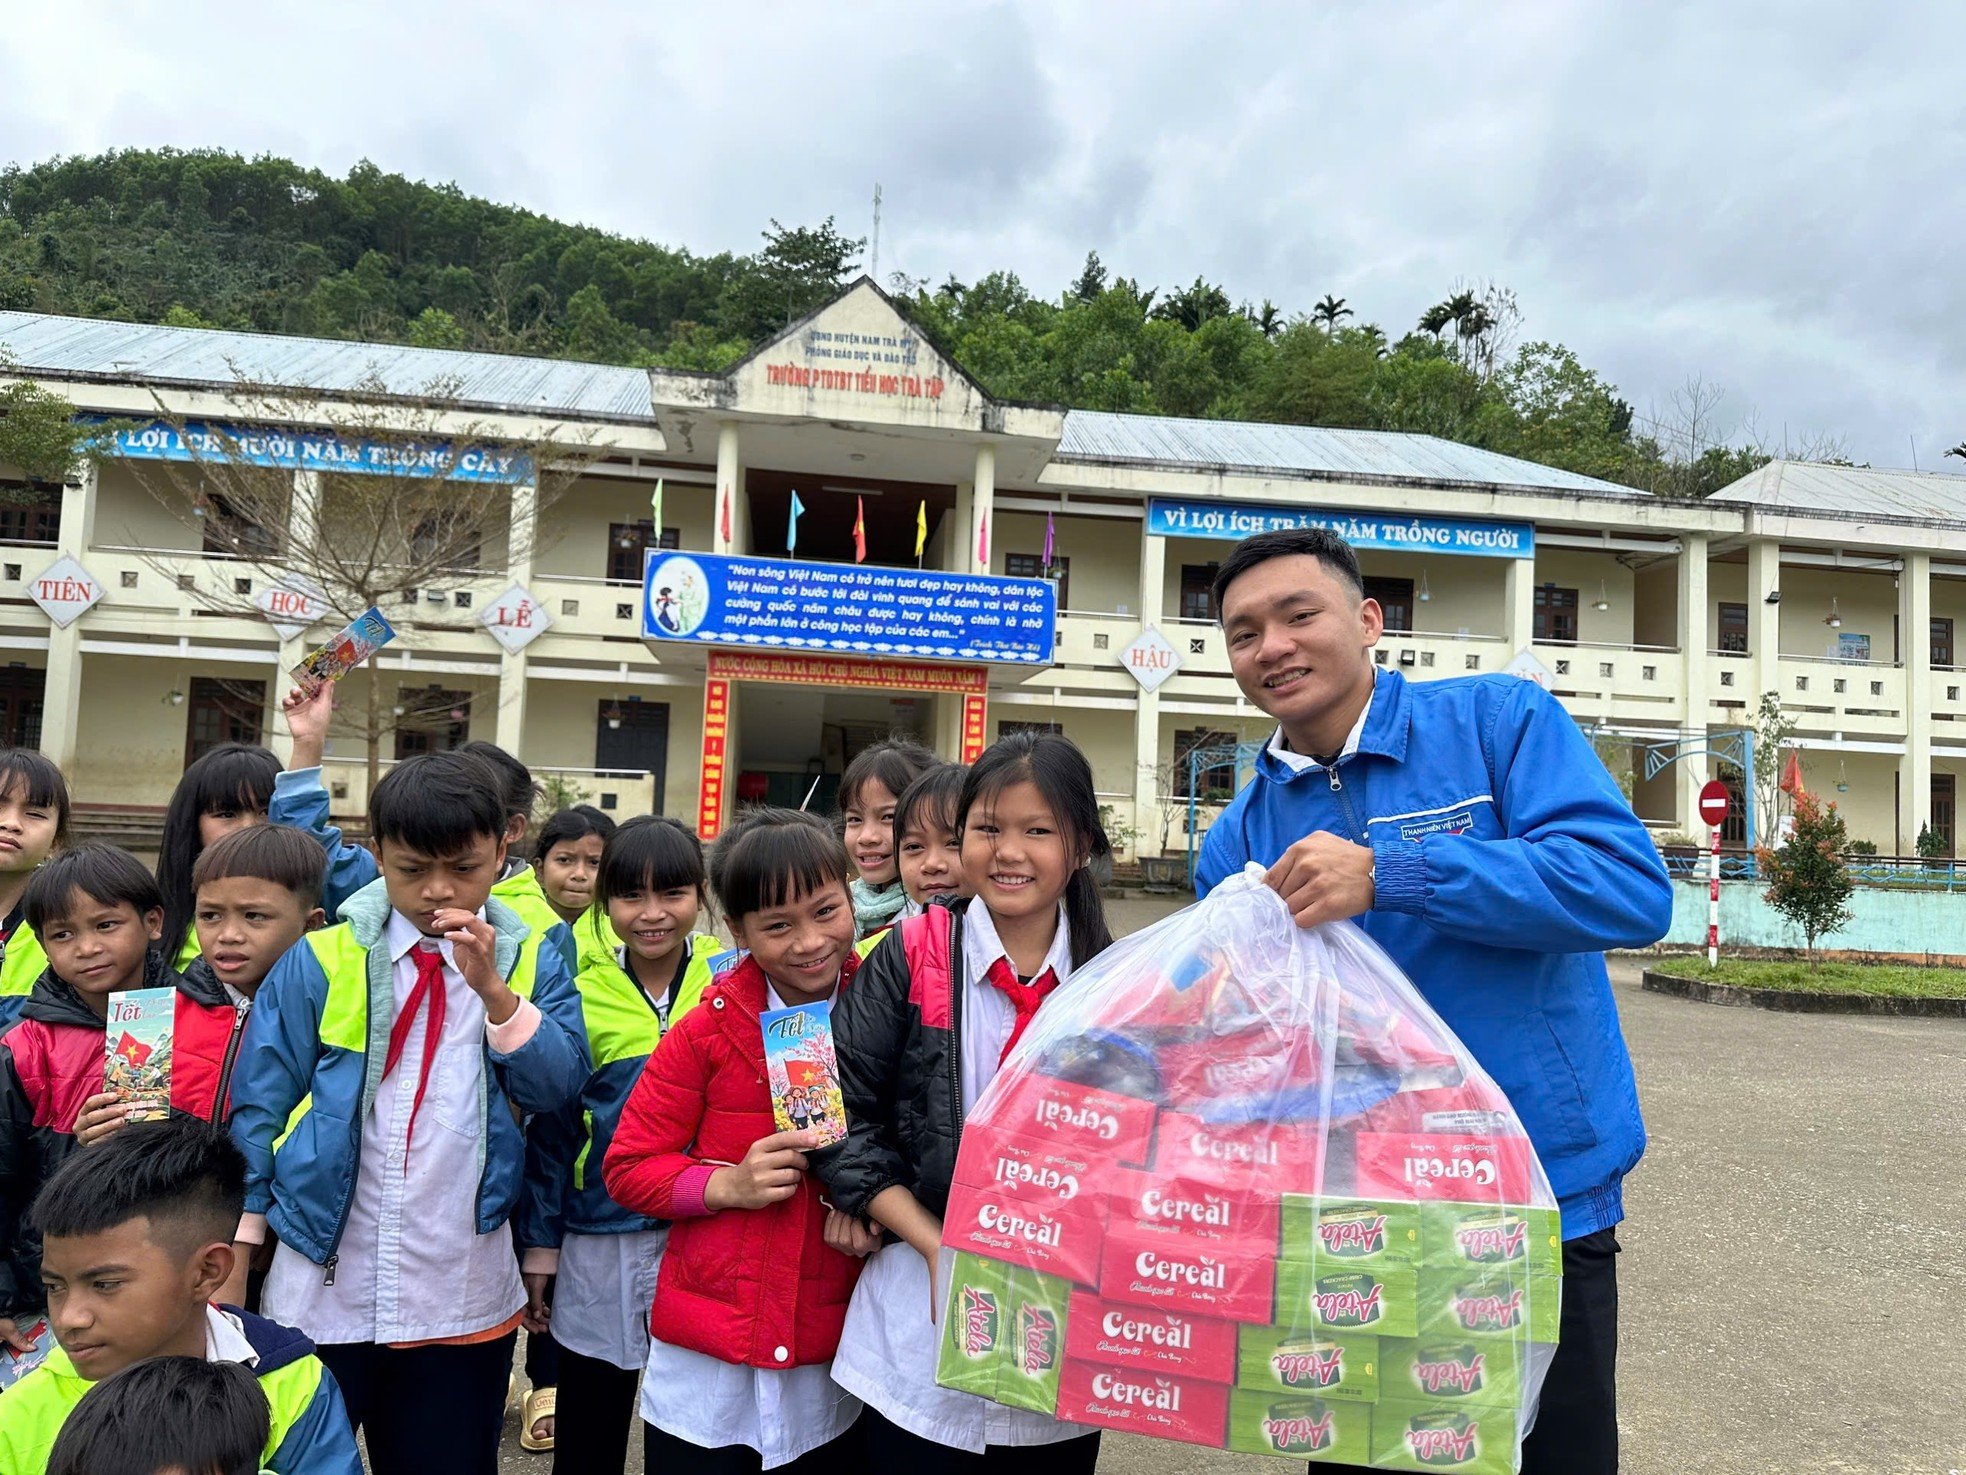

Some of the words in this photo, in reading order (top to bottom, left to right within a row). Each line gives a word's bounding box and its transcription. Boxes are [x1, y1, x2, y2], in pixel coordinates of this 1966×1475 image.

[834, 332, 859, 344] HUYỆN
[862, 335, 880, 345] NAM
[883, 334, 897, 346] TRÀ
[834, 347, 851, 359] GIÁO
[854, 350, 869, 363] DỤC
[872, 350, 882, 362] VÀ
[767, 361, 810, 387] TRƯỜNG
[879, 375, 899, 397] HỌC
[901, 374, 921, 397] TRÀ
[126, 428, 169, 452] LỢI
[302, 439, 361, 464] NĂM
[1164, 507, 1187, 527] VÌ
[1192, 511, 1225, 533] LỢI
[1229, 511, 1265, 532] ÍCH
[1332, 517, 1377, 540] NĂM
[1382, 519, 1451, 544] TRỒNG
[1455, 528, 1519, 549] NGƯỜI
[38, 576, 92, 602] TIÊN
[727, 580, 749, 594] Việt
[752, 582, 778, 595] Nam
[782, 585, 797, 596] có
[801, 586, 829, 598] bước
[832, 588, 847, 599] tới
[850, 589, 868, 600] đài
[872, 591, 894, 603] vinh
[898, 595, 933, 608] quang
[936, 593, 953, 607] để
[954, 597, 979, 609] sánh
[983, 599, 1000, 610] vai
[1003, 600, 1020, 611] với
[1022, 601, 1044, 613] các
[758, 566, 786, 581] sông
[789, 568, 810, 582] Việt
[811, 570, 837, 583] Nam
[840, 572, 855, 584] có
[857, 573, 873, 585] trở
[874, 575, 894, 587] nên
[897, 577, 918, 588] tươi
[919, 578, 941, 591] đẹp
[943, 580, 963, 593] hay
[965, 582, 1000, 595] không,
[1003, 584, 1024, 596] dân
[1026, 586, 1044, 599] tộc
[498, 599, 532, 628] LỄ
[724, 613, 747, 627] một
[748, 614, 778, 628] phần
[780, 617, 798, 628] lớn
[800, 619, 810, 629] ở
[810, 620, 839, 634] công
[841, 622, 862, 635] học
[864, 623, 884, 637] tập
[885, 623, 907, 636] của
[908, 626, 930, 638] các
[725, 597, 762, 611] cường
[767, 599, 797, 613] quốc
[802, 603, 828, 614] năm
[833, 604, 862, 616] châu
[868, 607, 897, 620] được
[902, 609, 923, 622] hay
[928, 611, 965, 626] không,
[970, 613, 1000, 626] chính
[1005, 615, 1018, 627] là
[1022, 617, 1044, 629] nhờ
[715, 655, 741, 670] NƯỚC
[743, 656, 768, 673] CỘNG
[809, 661, 826, 678] HỘI
[828, 660, 848, 677] CHỦ
[850, 664, 879, 679] NGHĨA
[882, 666, 902, 681] VIỆT
[905, 669, 926, 681] NAM
[927, 669, 953, 683] MUÔN
[955, 670, 975, 684] NĂM
[1132, 644, 1172, 673] HẬU
[1403, 828, 1427, 837] THANH
[1426, 823, 1441, 833] NIÊN
[1442, 820, 1456, 831] VIỆT
[1456, 817, 1471, 827] NAM
[114, 1000, 142, 1022] Tết
[769, 1012, 805, 1038] Tết
[1035, 1099, 1119, 1139] Cereal
[1190, 1132, 1278, 1166] Cereal
[995, 1157, 1079, 1199] Cereal
[1404, 1157, 1496, 1186] Cereal
[978, 1204, 1062, 1247] Cereal
[1141, 1190, 1230, 1226] Cereal
[1317, 1214, 1388, 1252] Atela
[1455, 1220, 1528, 1259] Atela
[1135, 1251, 1225, 1289] Cereal
[964, 1283, 995, 1358] Atela
[1312, 1284, 1384, 1322] Atela
[1452, 1289, 1524, 1327] Atela
[1022, 1300, 1054, 1376] Atela
[1102, 1311, 1192, 1349] Cereal
[1272, 1346, 1345, 1385] Atela
[1413, 1353, 1486, 1392] Atela
[1092, 1373, 1180, 1412] Cereal
[1263, 1410, 1335, 1449] Atela
[1405, 1421, 1479, 1461] Atela
